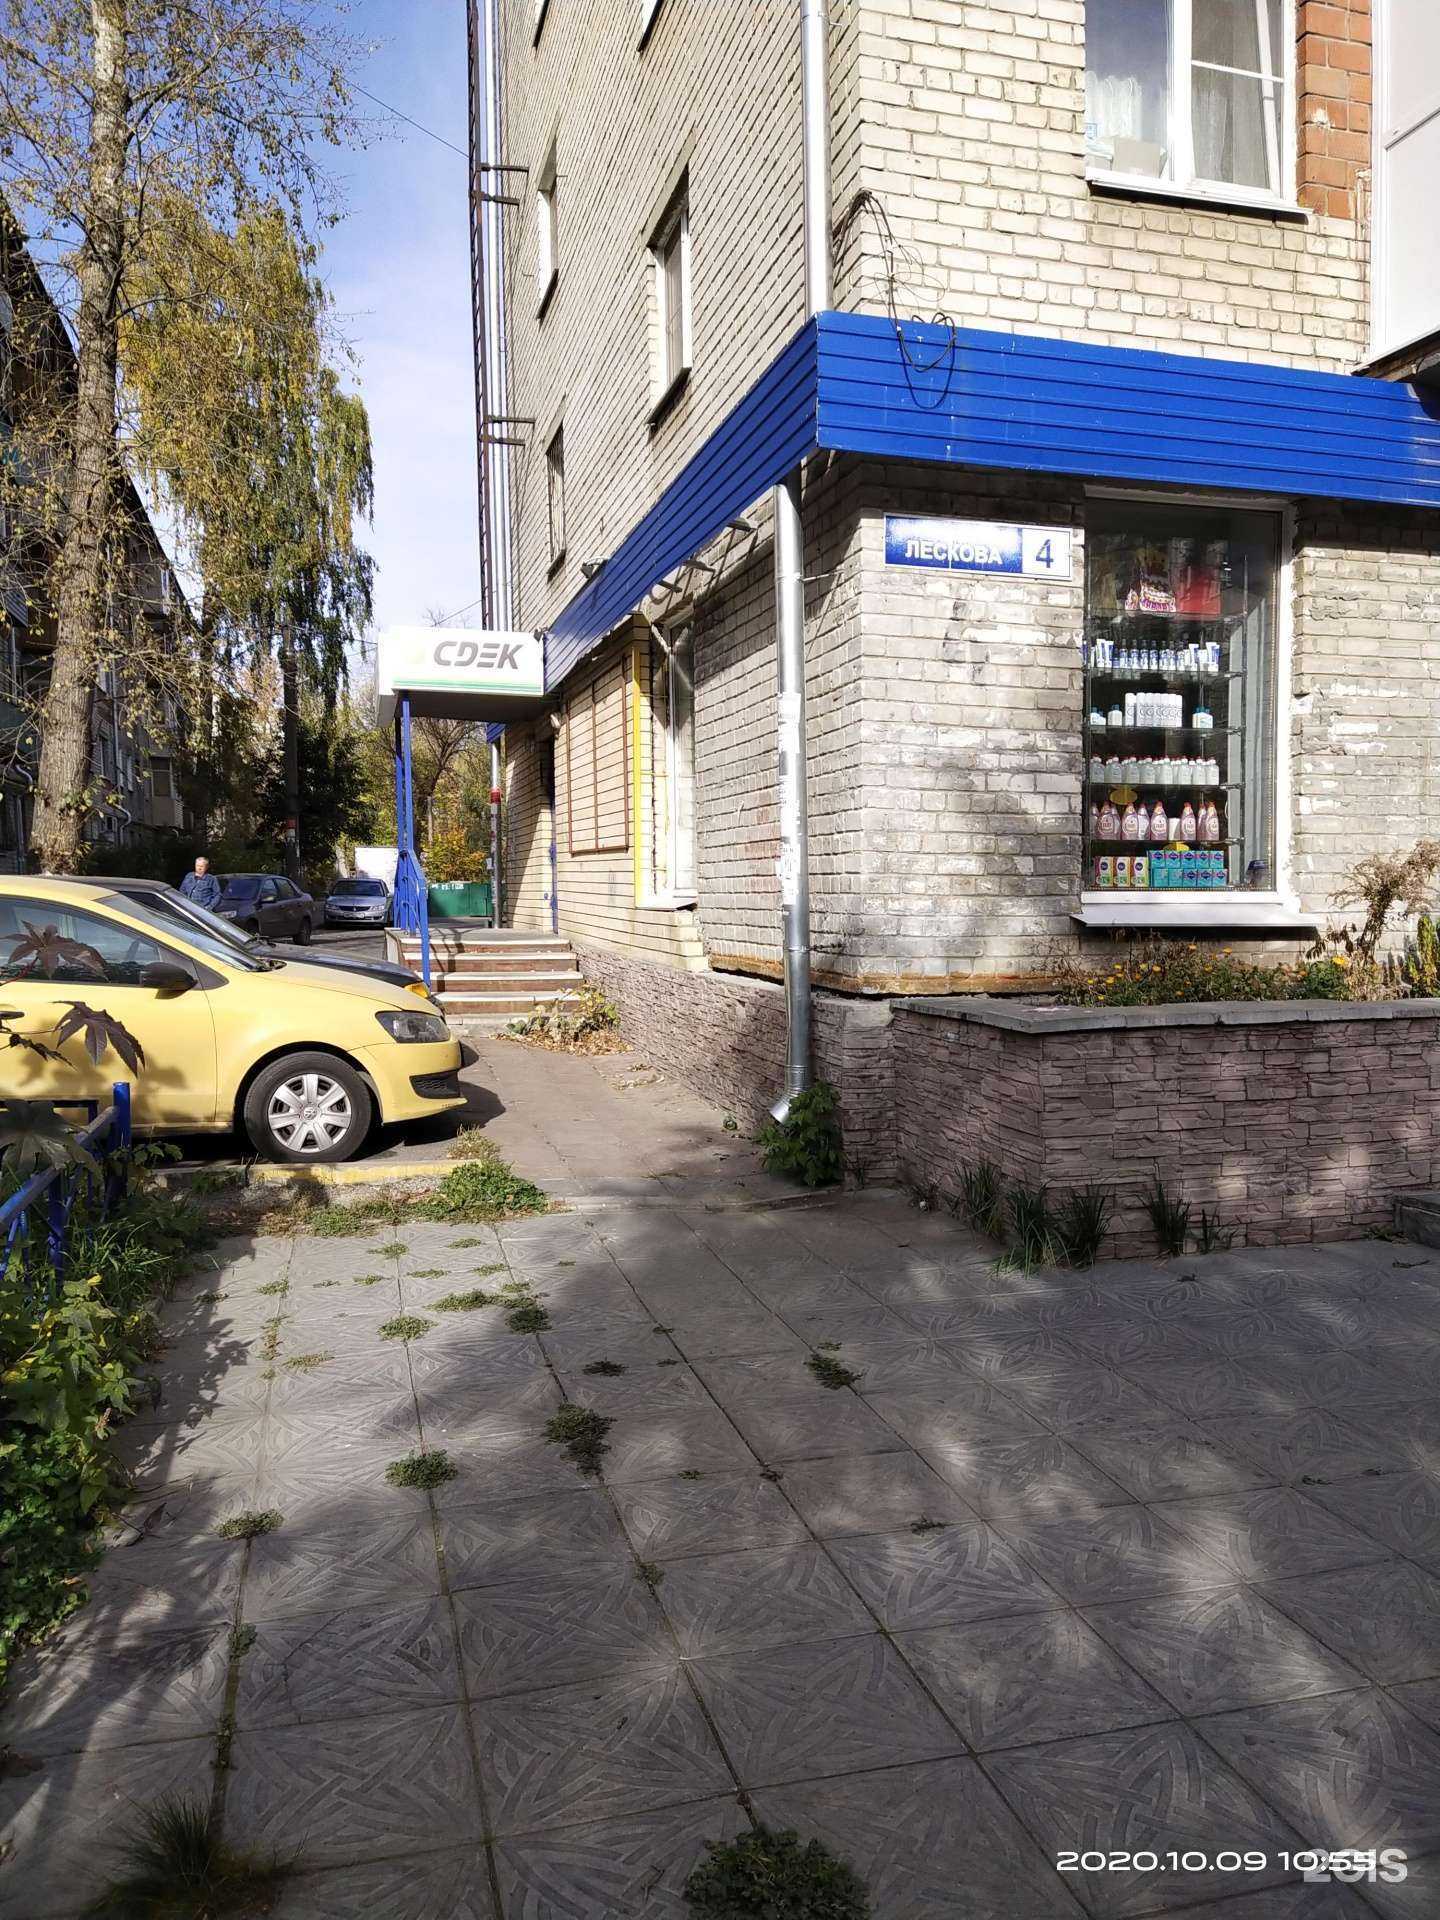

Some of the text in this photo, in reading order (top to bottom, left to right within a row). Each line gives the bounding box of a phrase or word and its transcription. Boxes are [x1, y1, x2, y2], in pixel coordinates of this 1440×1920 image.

[905, 538, 1055, 568] ЛЕСКОВА 4
[433, 641, 523, 669] CDEK
